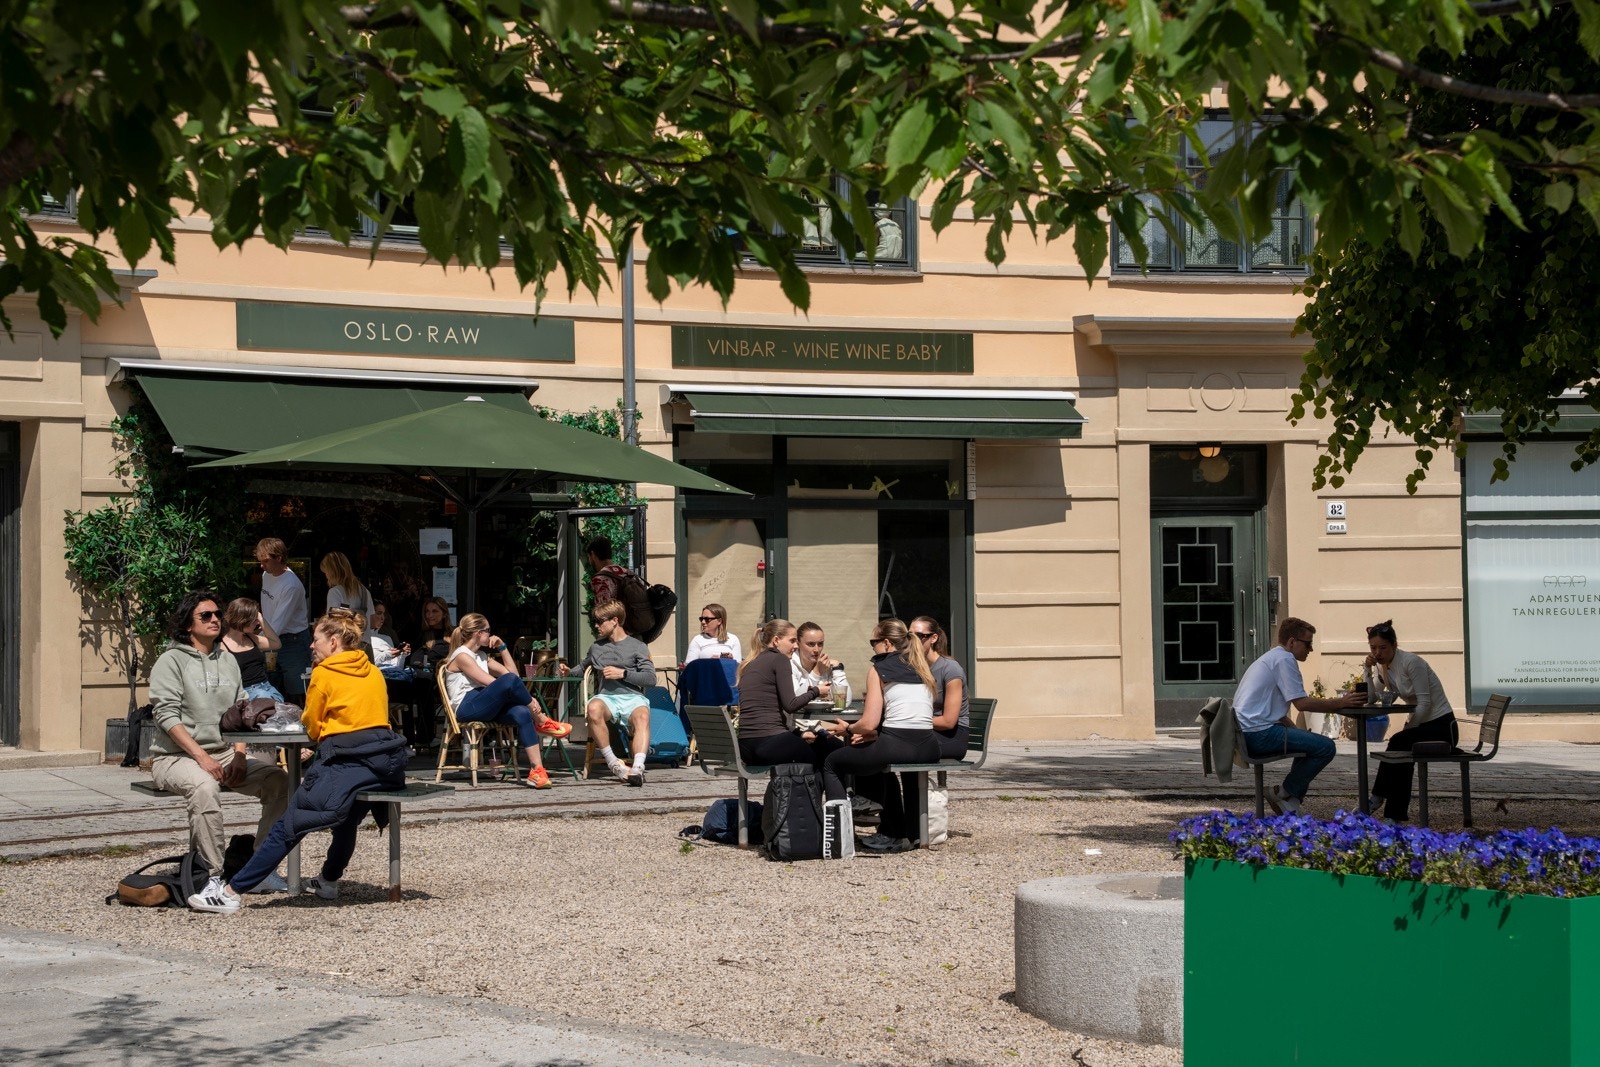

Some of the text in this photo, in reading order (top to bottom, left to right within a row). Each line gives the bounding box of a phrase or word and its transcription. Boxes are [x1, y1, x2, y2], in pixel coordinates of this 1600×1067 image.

[707, 338, 775, 357] VINBAR
[793, 341, 839, 359] WINE
[844, 342, 891, 360] WINE
[896, 344, 942, 361] BABY
[1330, 504, 1343, 515] 82
[1529, 594, 1600, 603] ADAMSTUEN
